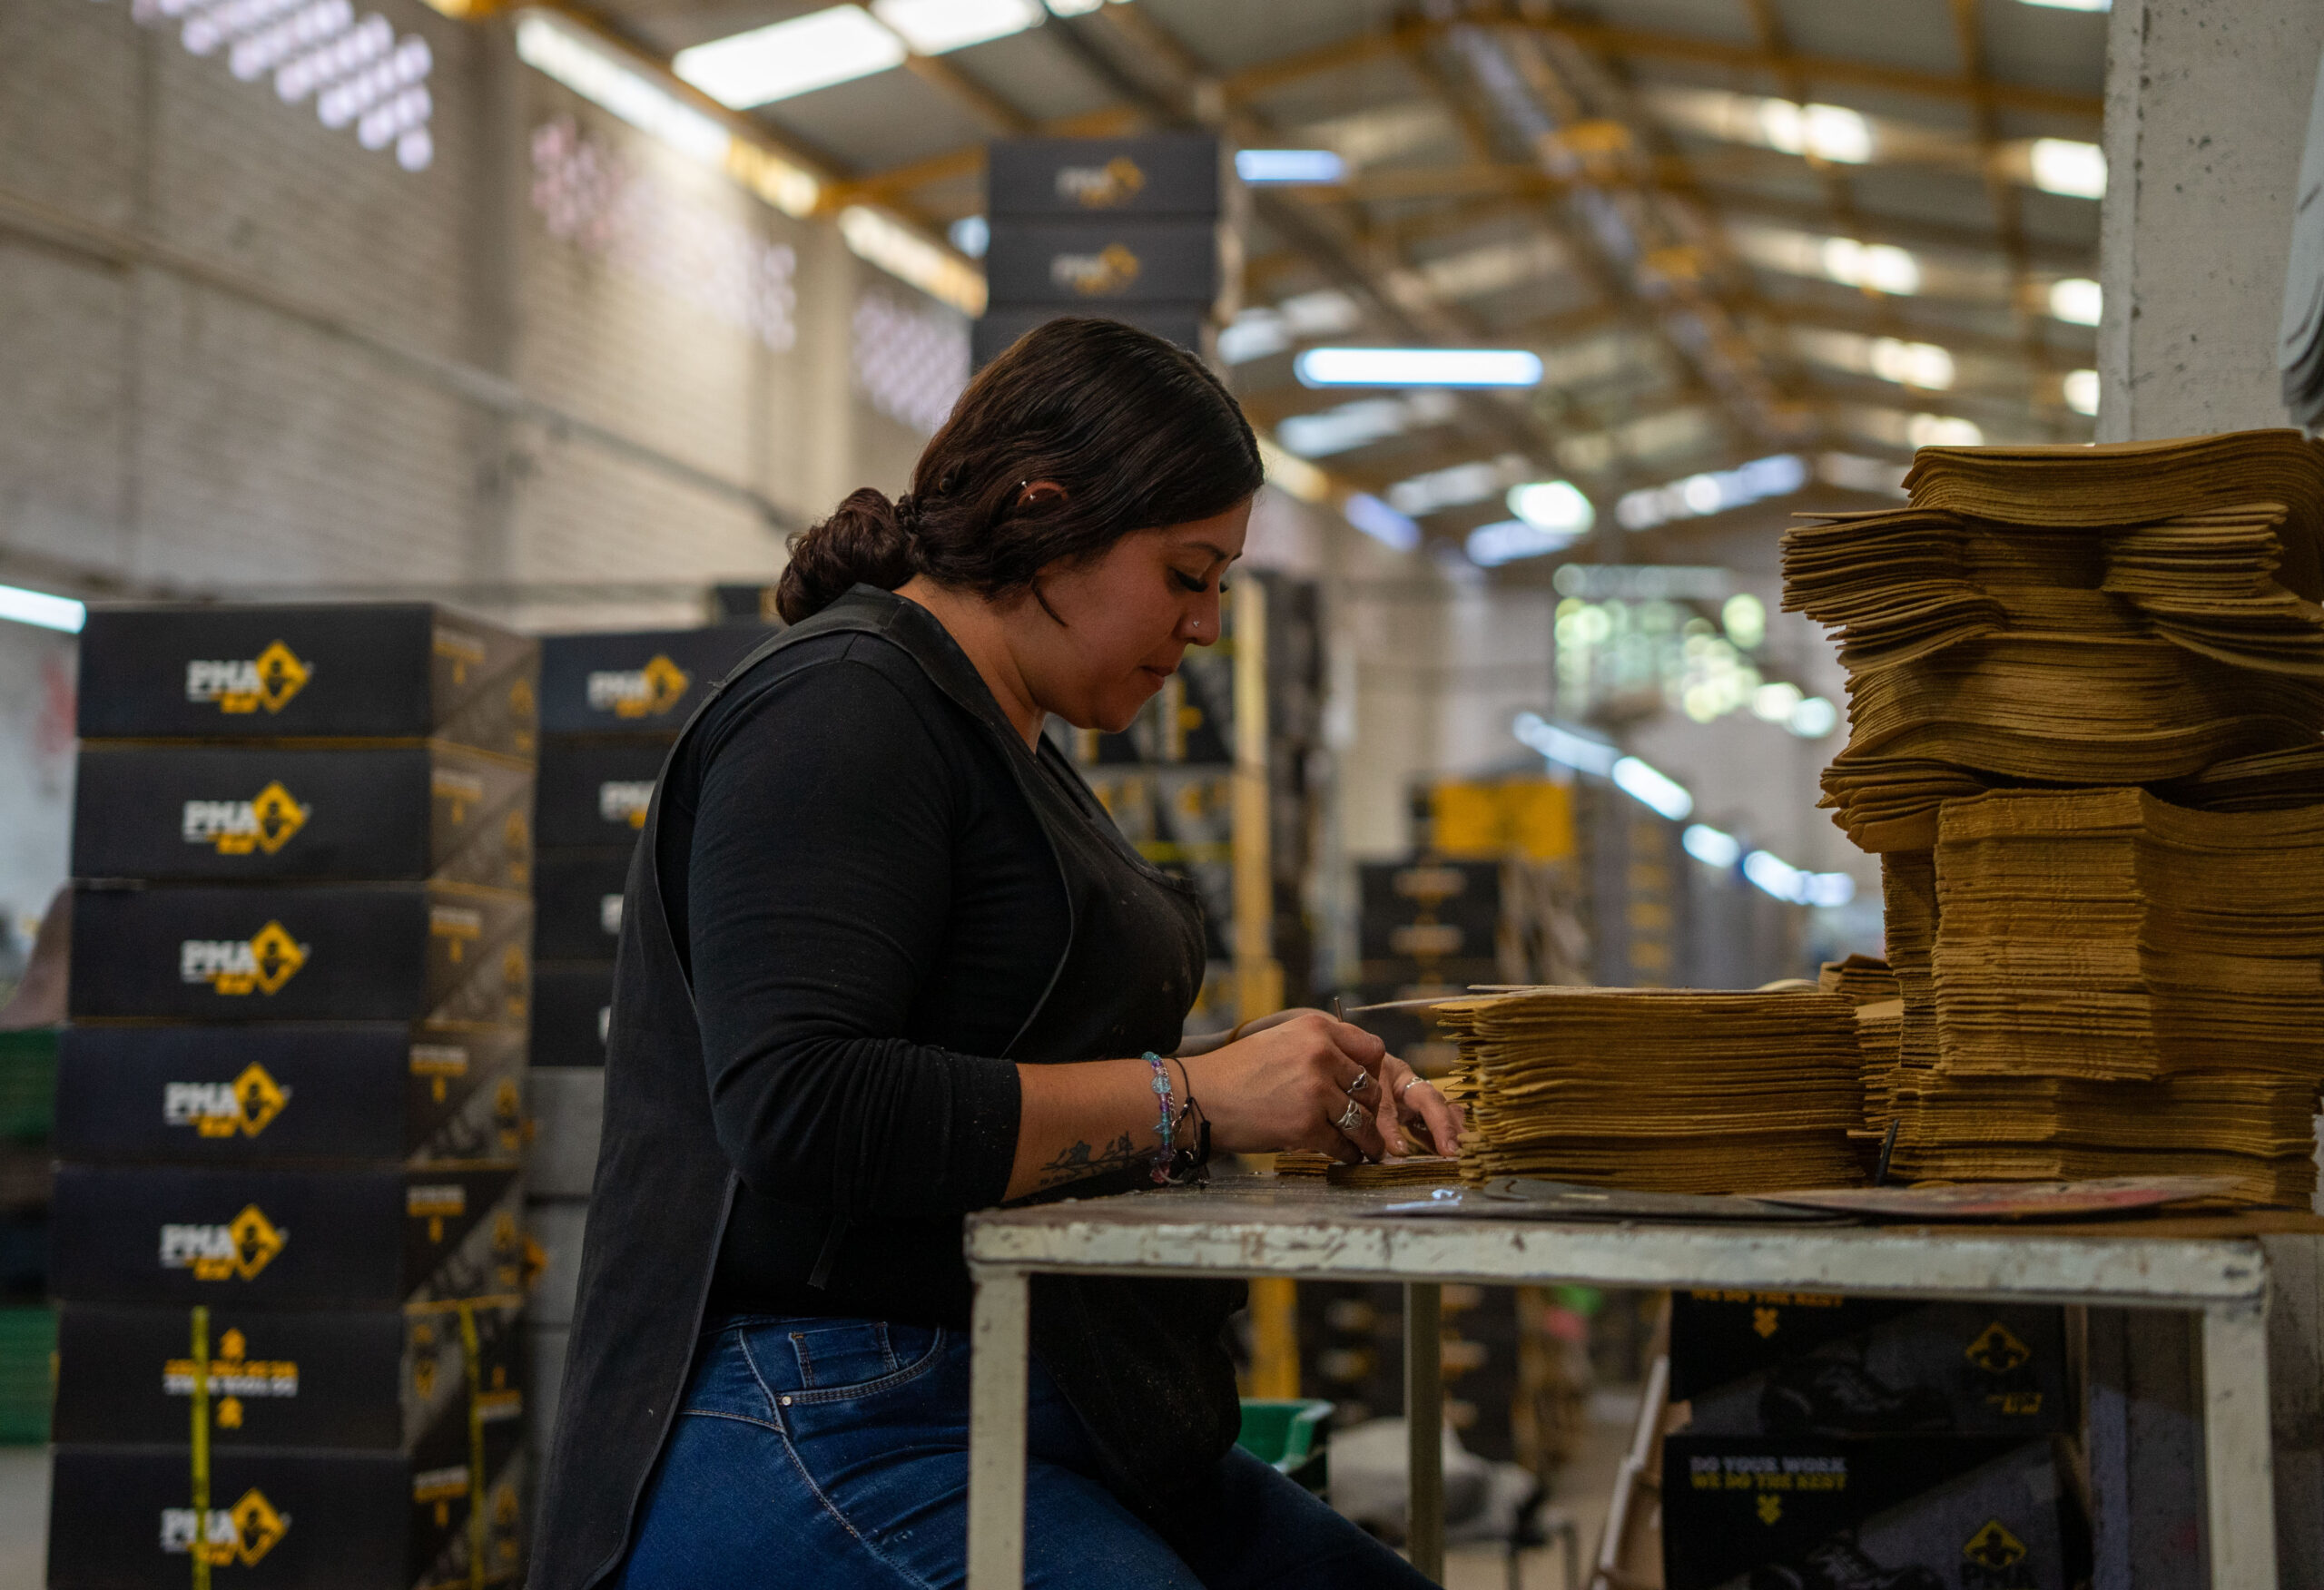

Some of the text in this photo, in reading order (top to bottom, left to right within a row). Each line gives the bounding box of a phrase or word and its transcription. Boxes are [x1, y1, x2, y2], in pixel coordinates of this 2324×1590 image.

[187, 660, 261, 692] PMA
[182, 800, 259, 835] PMA
[180, 940, 258, 975] PMA
[164, 1083, 240, 1116] PMA
[160, 1224, 236, 1259] PMA
[1690, 1457, 1720, 1473] DO
